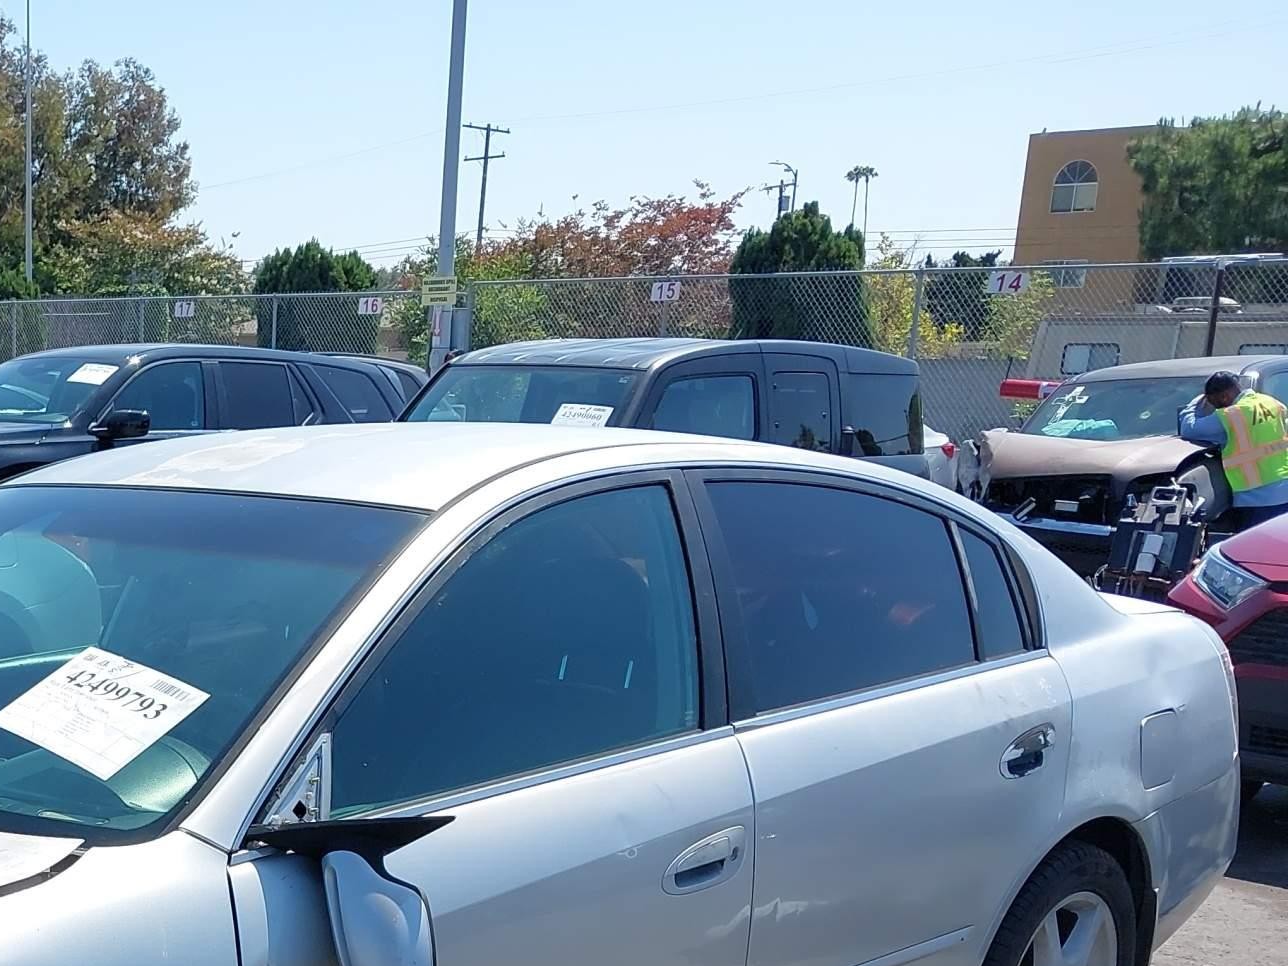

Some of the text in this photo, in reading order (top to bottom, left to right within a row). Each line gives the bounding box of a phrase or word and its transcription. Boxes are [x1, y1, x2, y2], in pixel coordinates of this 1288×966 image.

[657, 282, 676, 300] 15
[996, 273, 1022, 292] 14
[179, 301, 191, 316] 17
[364, 298, 378, 313] 16
[66, 669, 168, 720] 42499793
